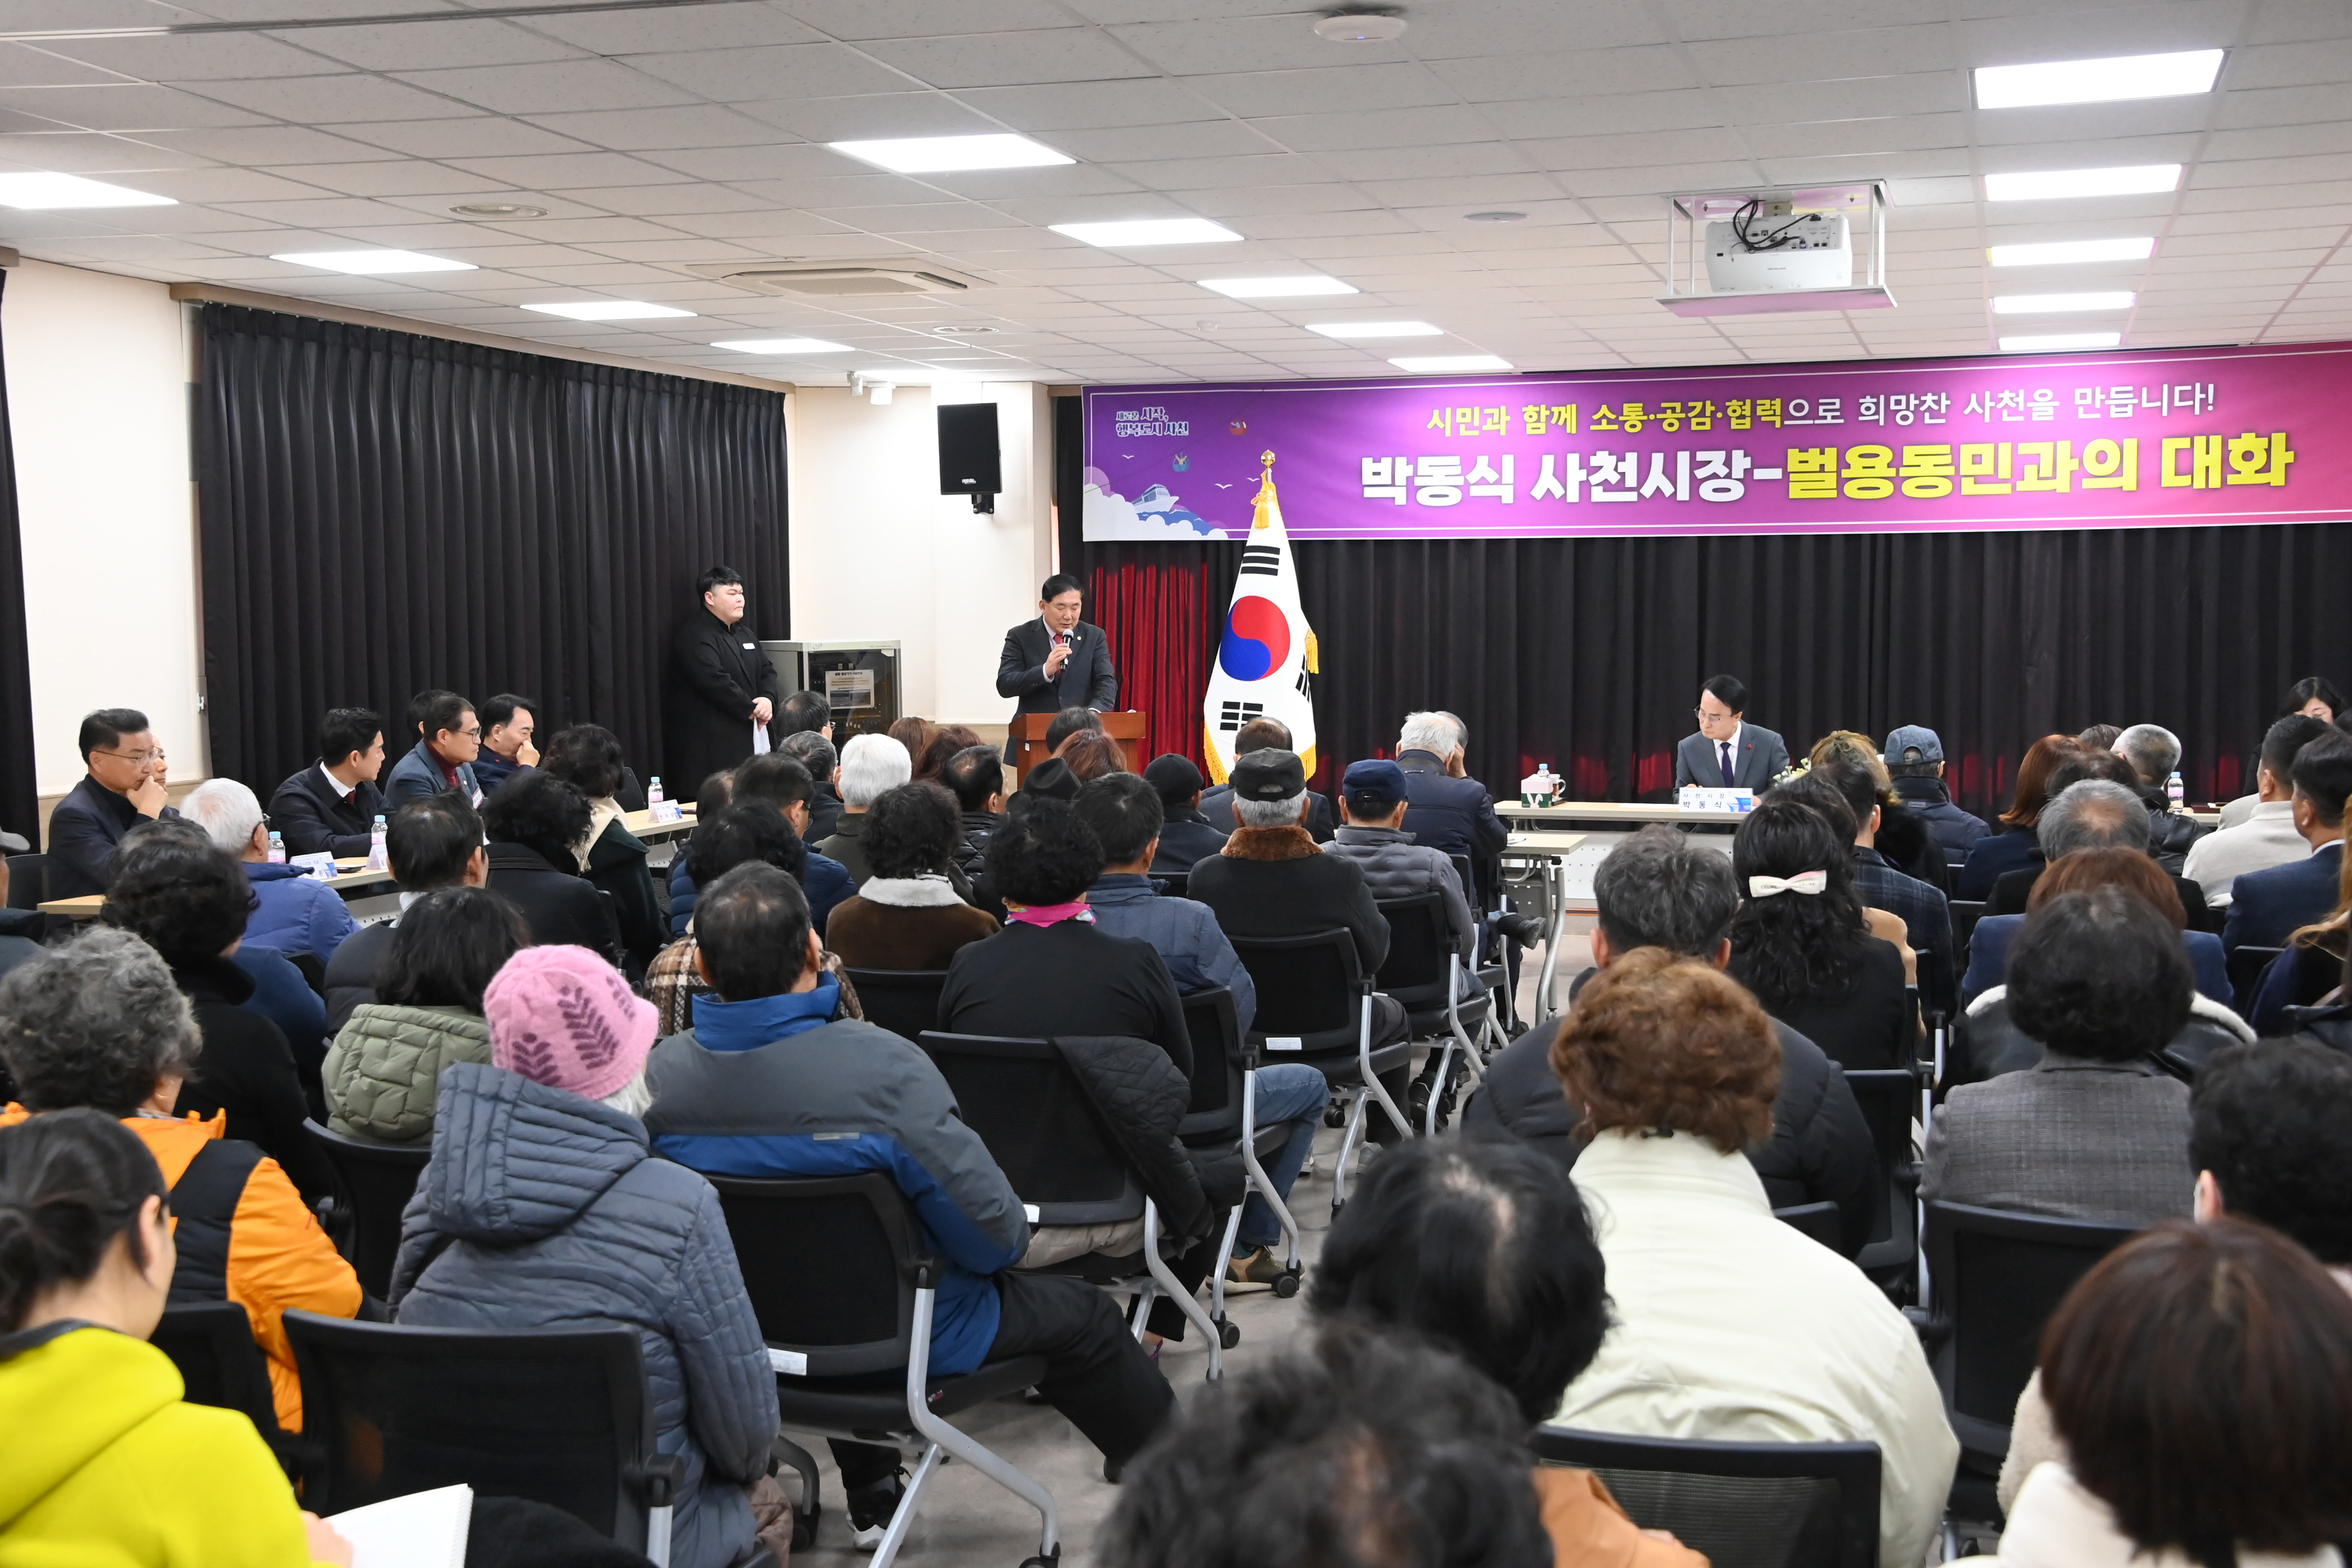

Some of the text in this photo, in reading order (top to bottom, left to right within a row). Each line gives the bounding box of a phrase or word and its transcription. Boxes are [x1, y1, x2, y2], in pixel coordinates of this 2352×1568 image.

[1116, 406, 1169, 422] 새로운 시작,
[1427, 406, 1512, 438] 시민과
[1522, 403, 1578, 435] 함께
[1859, 393, 1952, 426] 희망찬
[1963, 389, 2061, 424] 사천을
[2074, 383, 2215, 420] 만듭니다!
[1116, 422, 1163, 438] 행복도시
[1361, 454, 1515, 507] 박동식
[2162, 432, 2296, 490] 대화
